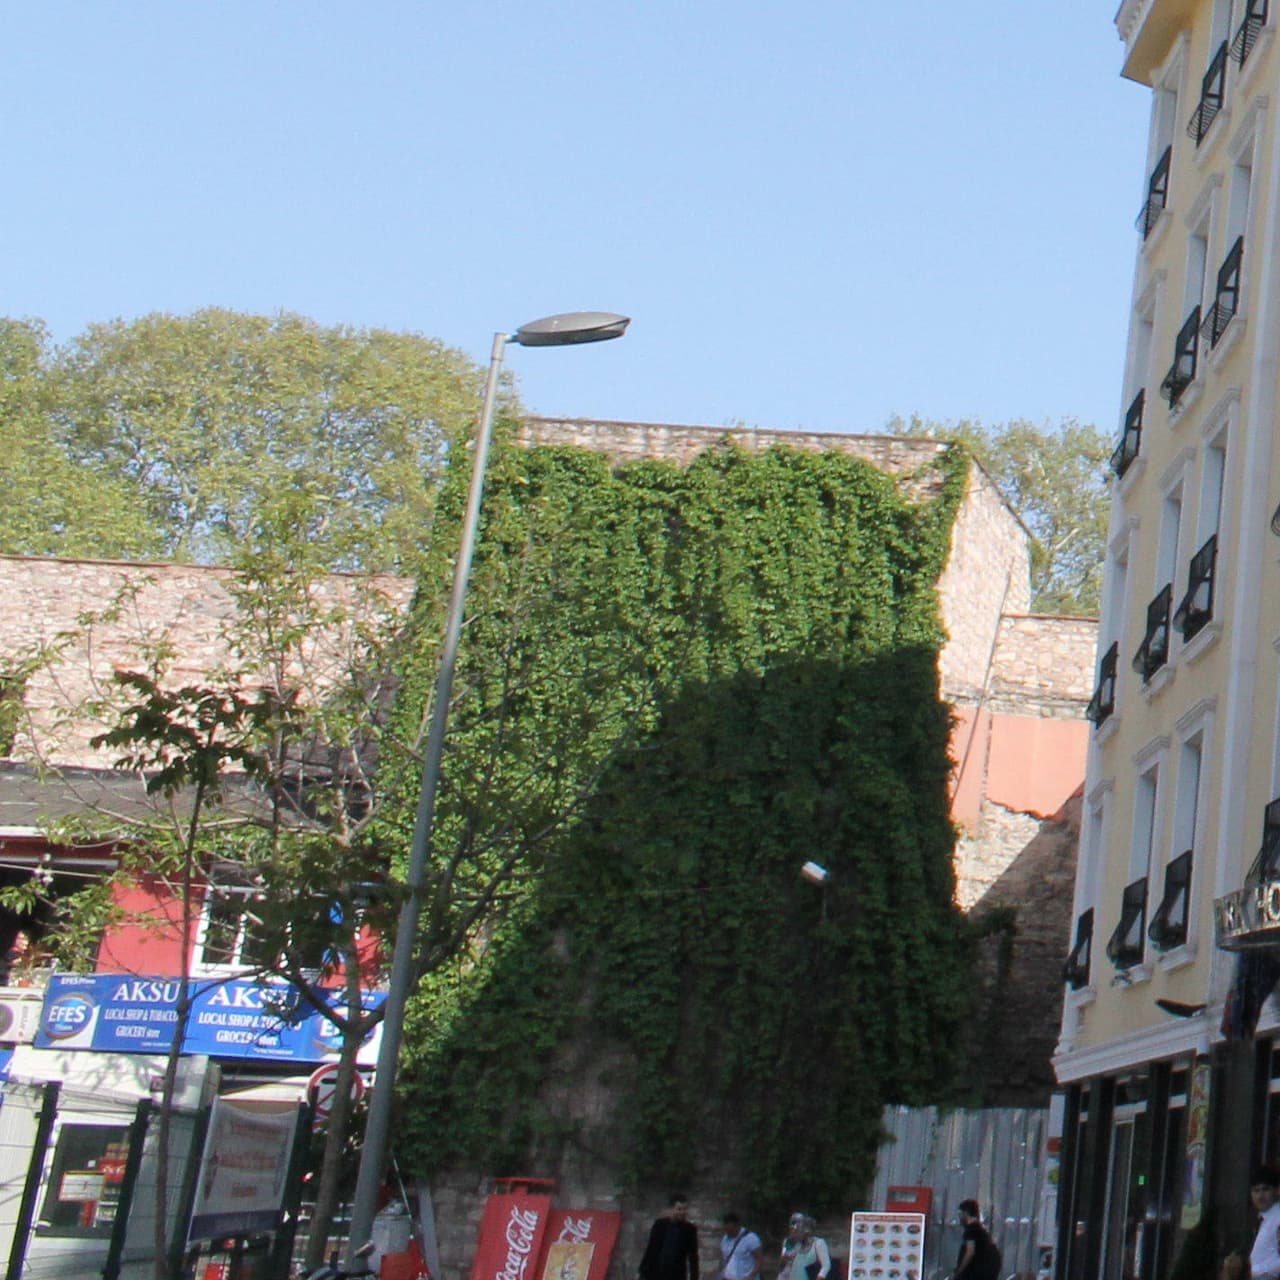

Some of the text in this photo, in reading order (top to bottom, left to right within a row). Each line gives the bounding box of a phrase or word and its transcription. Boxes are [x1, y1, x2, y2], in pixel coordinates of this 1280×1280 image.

[112, 981, 181, 1003] AKSU
[47, 1005, 86, 1023] EFES
[198, 1012, 227, 1026] LOCAL
[227, 1014, 252, 1028] SHOP
